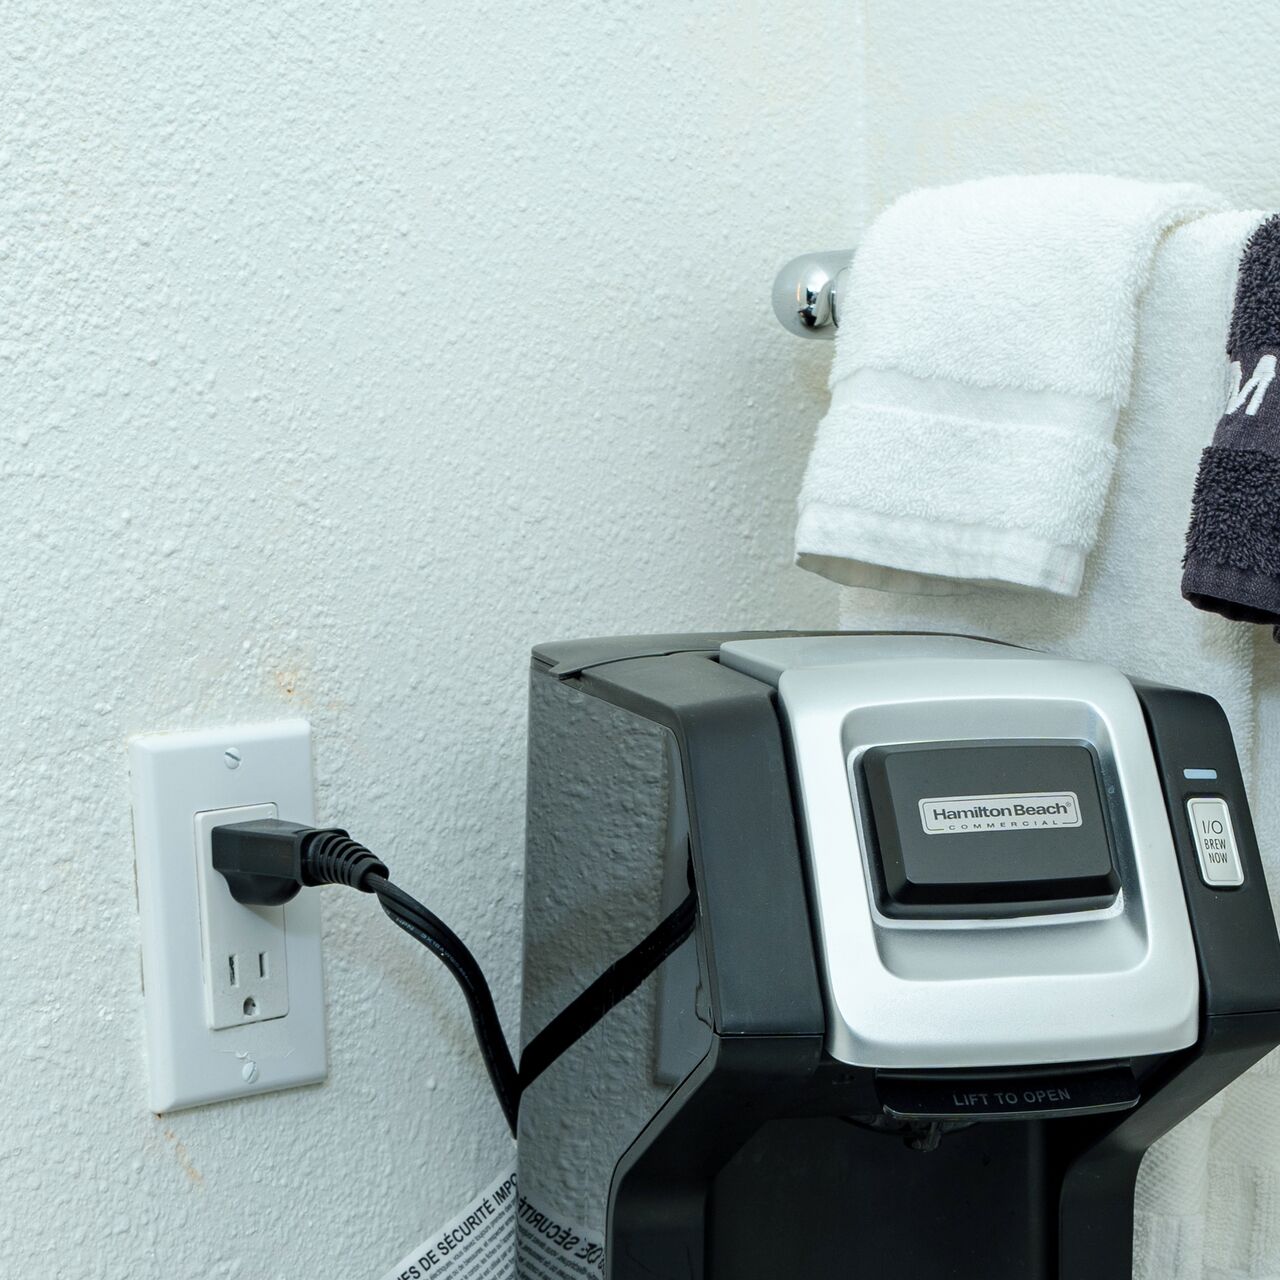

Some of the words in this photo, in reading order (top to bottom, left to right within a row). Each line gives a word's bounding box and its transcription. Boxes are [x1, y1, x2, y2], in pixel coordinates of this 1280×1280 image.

[933, 806, 1012, 821] Hamilton
[948, 820, 1059, 831] COMMERCIAL
[1204, 838, 1226, 850] BREW
[1208, 852, 1228, 864] NOW
[952, 1093, 988, 1106] LIFT
[994, 1092, 1018, 1104] TO
[1023, 1088, 1071, 1103] OPEN
[418, 1249, 440, 1272] DE
[436, 1197, 496, 1256] SÉCURITÉ
